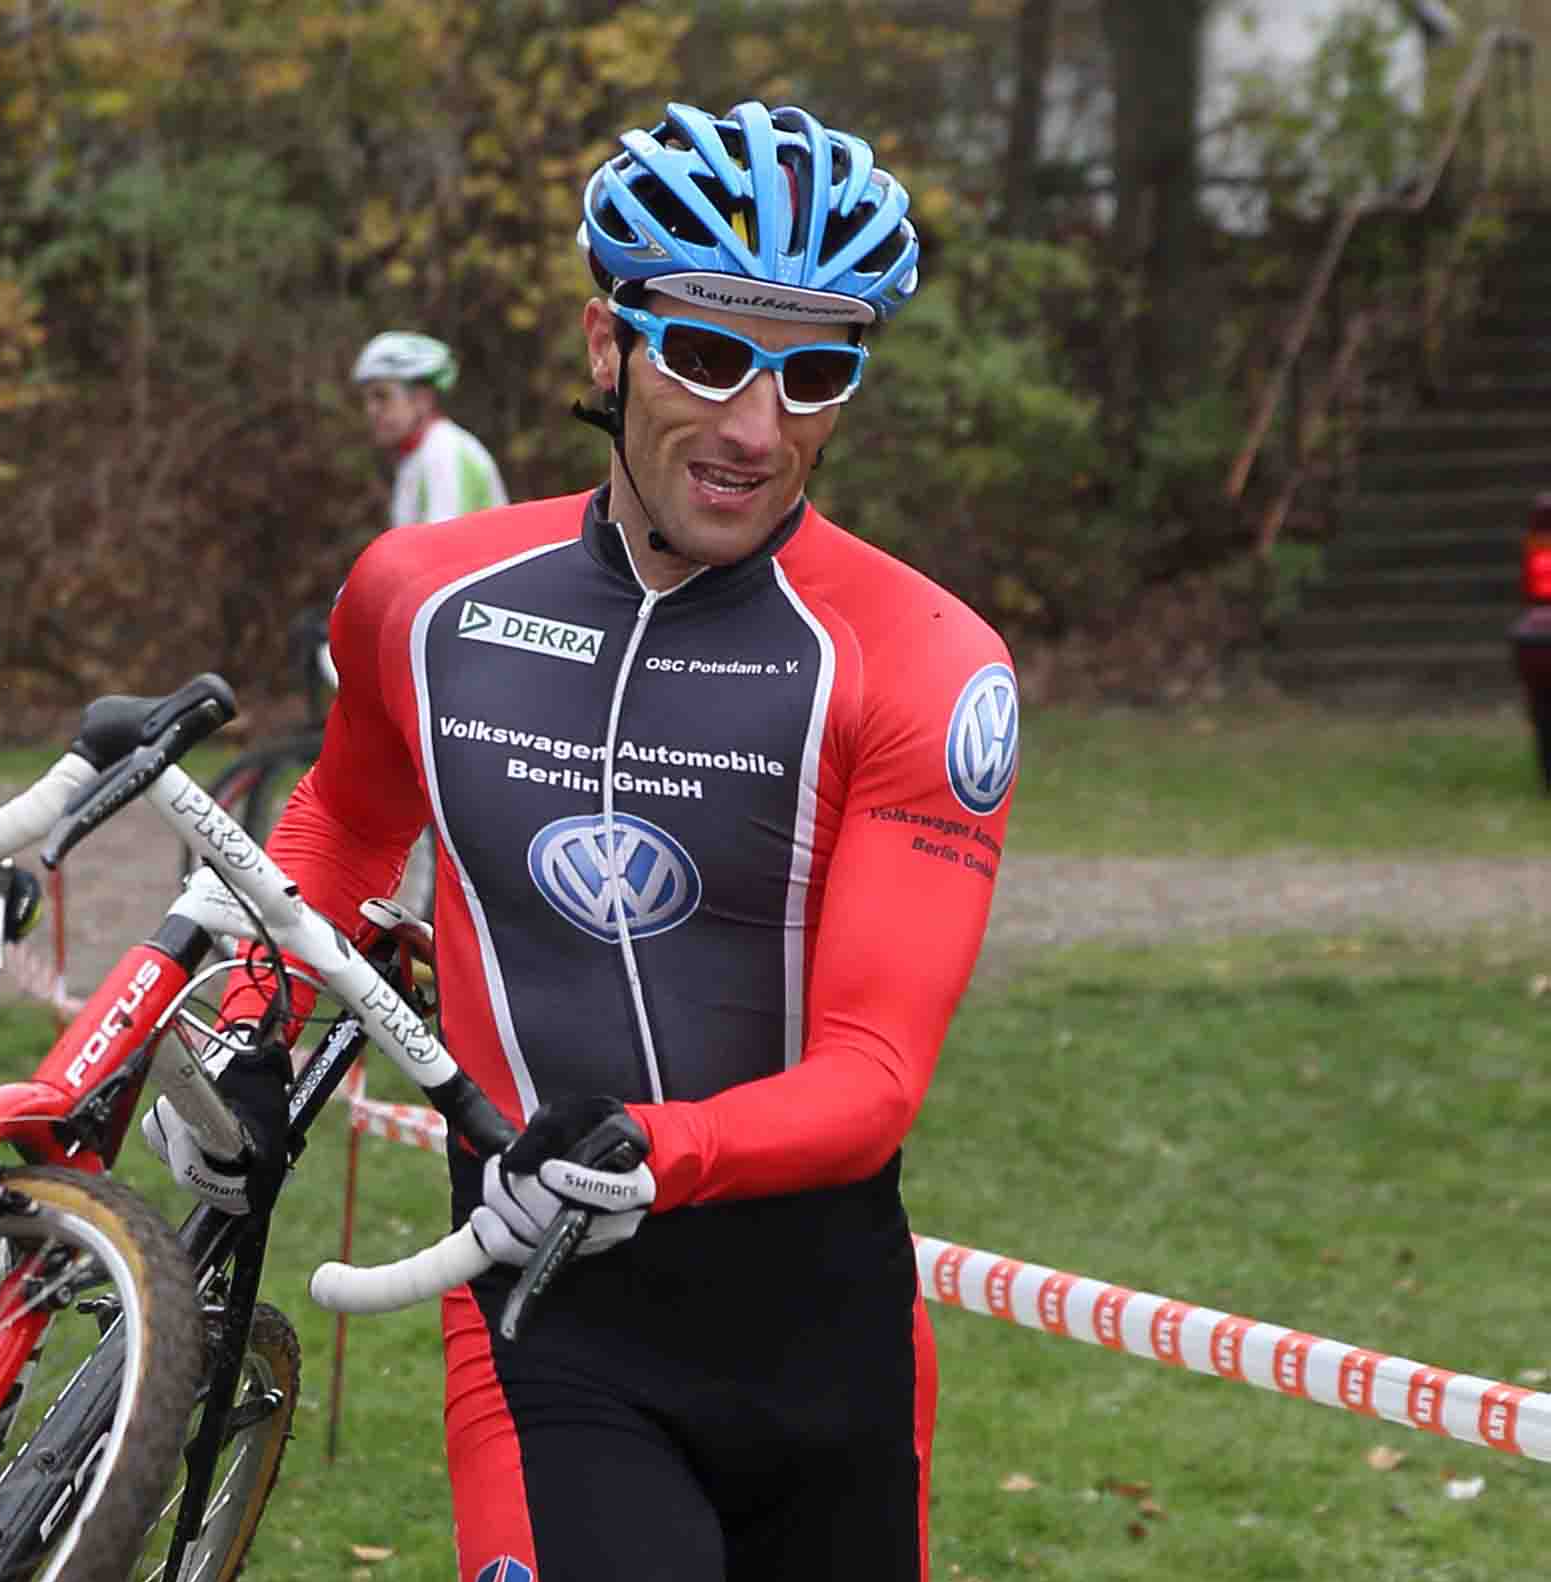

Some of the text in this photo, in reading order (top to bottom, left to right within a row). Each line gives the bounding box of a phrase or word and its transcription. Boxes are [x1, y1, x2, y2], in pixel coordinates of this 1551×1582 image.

[501, 616, 597, 657] DEKRA
[645, 656, 799, 675] OSC Potsdam e. V.
[439, 716, 785, 777] Volkswagen Automobile
[506, 758, 704, 800] Berlin GmbH
[64, 959, 161, 1088] FOCUS
